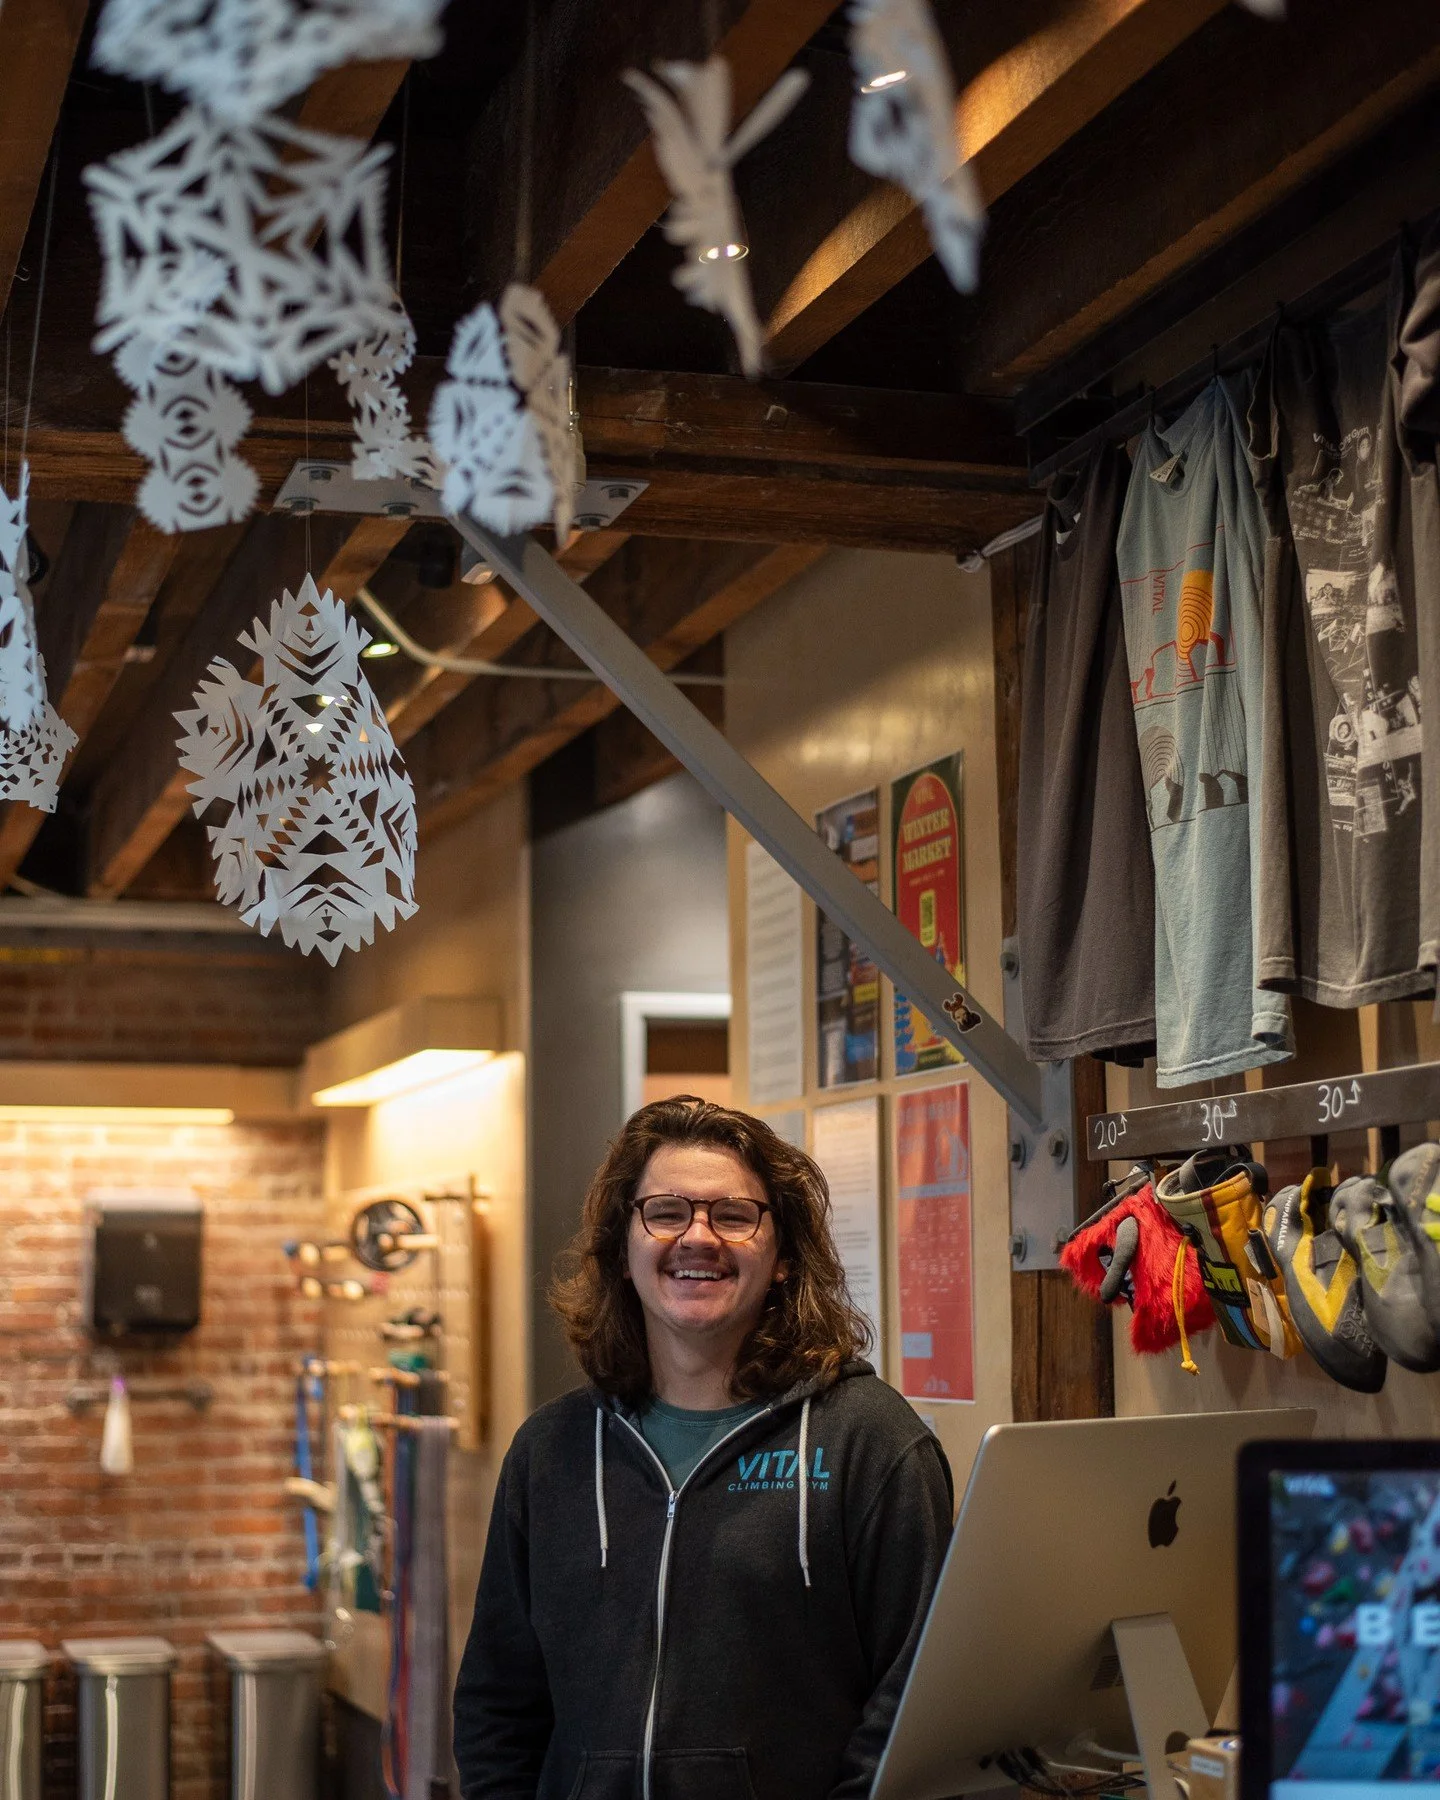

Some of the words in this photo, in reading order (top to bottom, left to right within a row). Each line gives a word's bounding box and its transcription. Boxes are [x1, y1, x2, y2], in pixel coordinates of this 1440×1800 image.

[903, 808, 951, 843] WINTER
[902, 836, 951, 874] MARKET
[1200, 1102, 1225, 1142] 30
[1318, 1084, 1344, 1124] 30
[1094, 1119, 1117, 1151] 20
[1276, 1193, 1295, 1251] UNPARALLEL
[727, 1480, 795, 1492] CLIMBING
